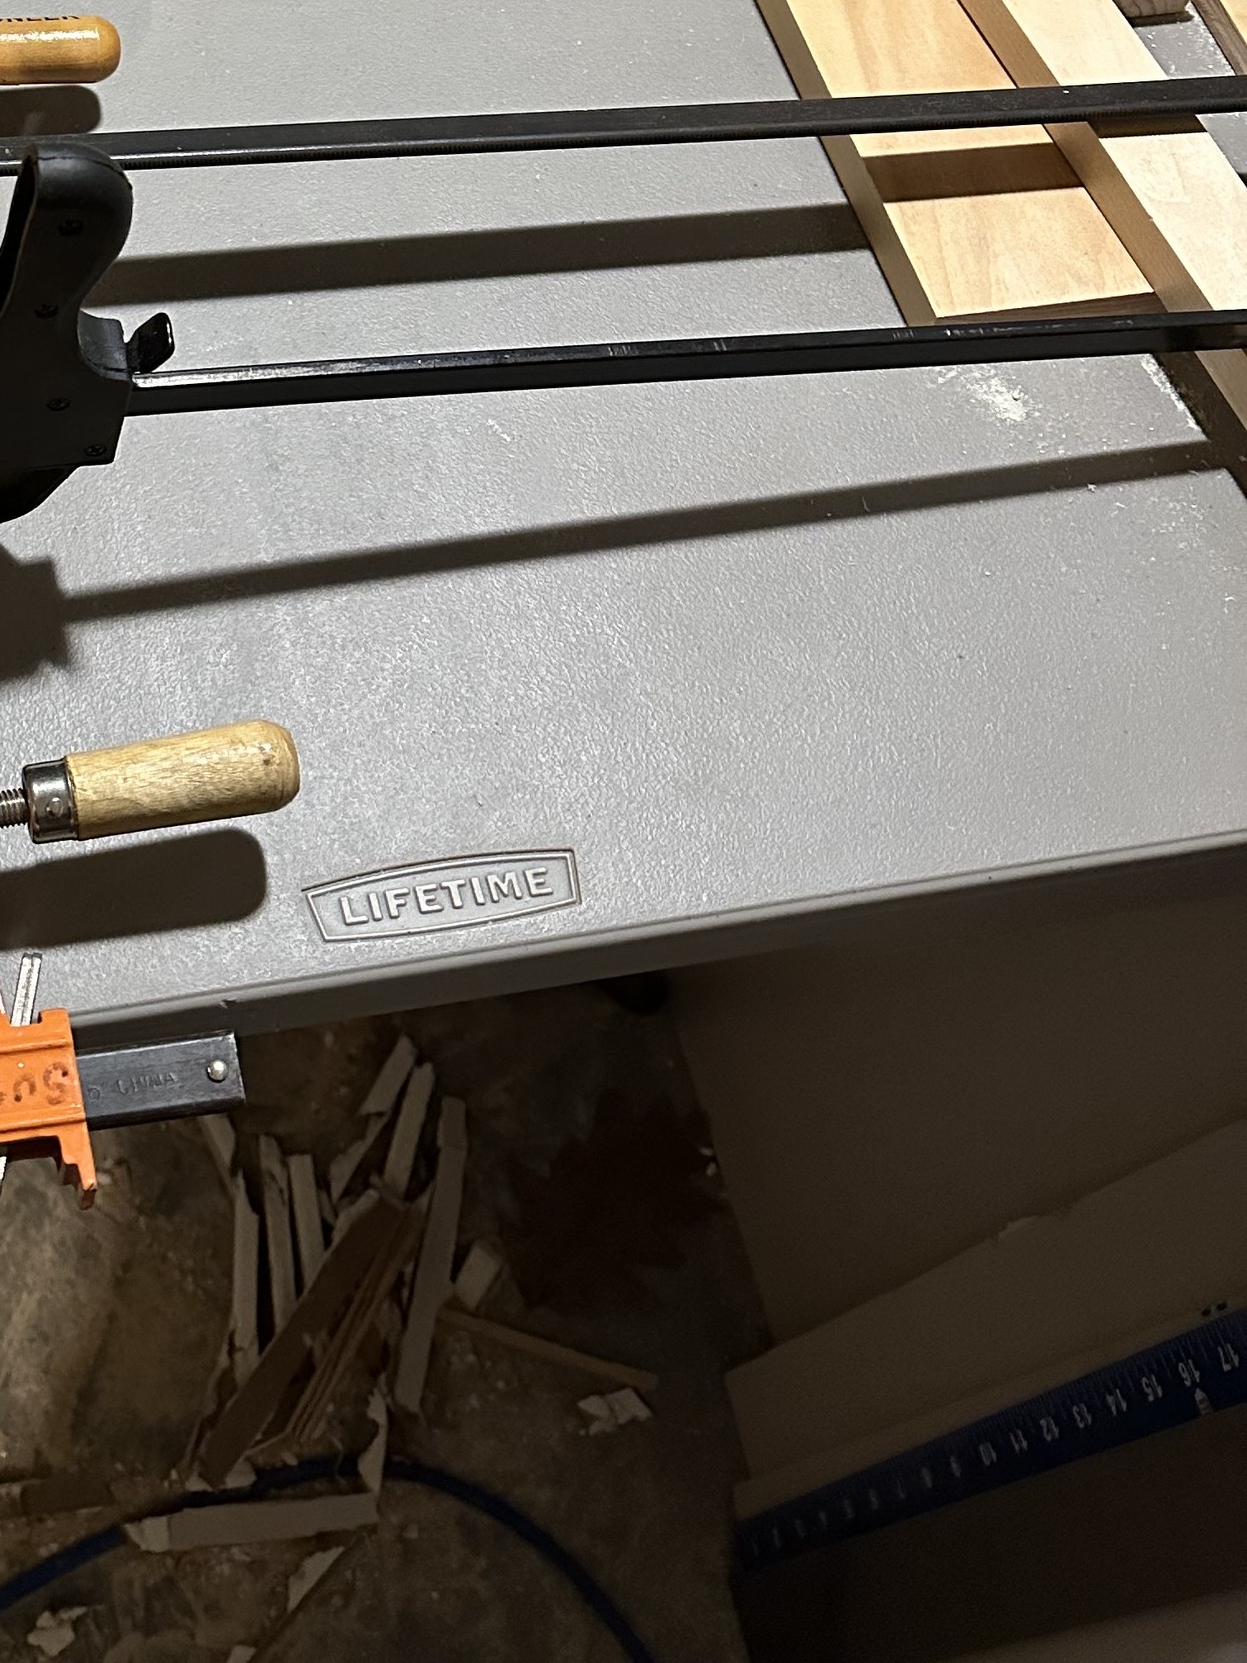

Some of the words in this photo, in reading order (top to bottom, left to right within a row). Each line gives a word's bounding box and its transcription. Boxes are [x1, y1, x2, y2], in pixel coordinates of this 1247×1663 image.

[336, 865, 557, 930] LIFETIME
[1008, 1427, 1029, 1454] 11
[1039, 1415, 1060, 1442] 12
[1071, 1401, 1093, 1429] 13
[1105, 1387, 1128, 1416] 14
[1141, 1373, 1164, 1402] 15
[1178, 1358, 1201, 1387] 16
[1217, 1341, 1241, 1373] 17
